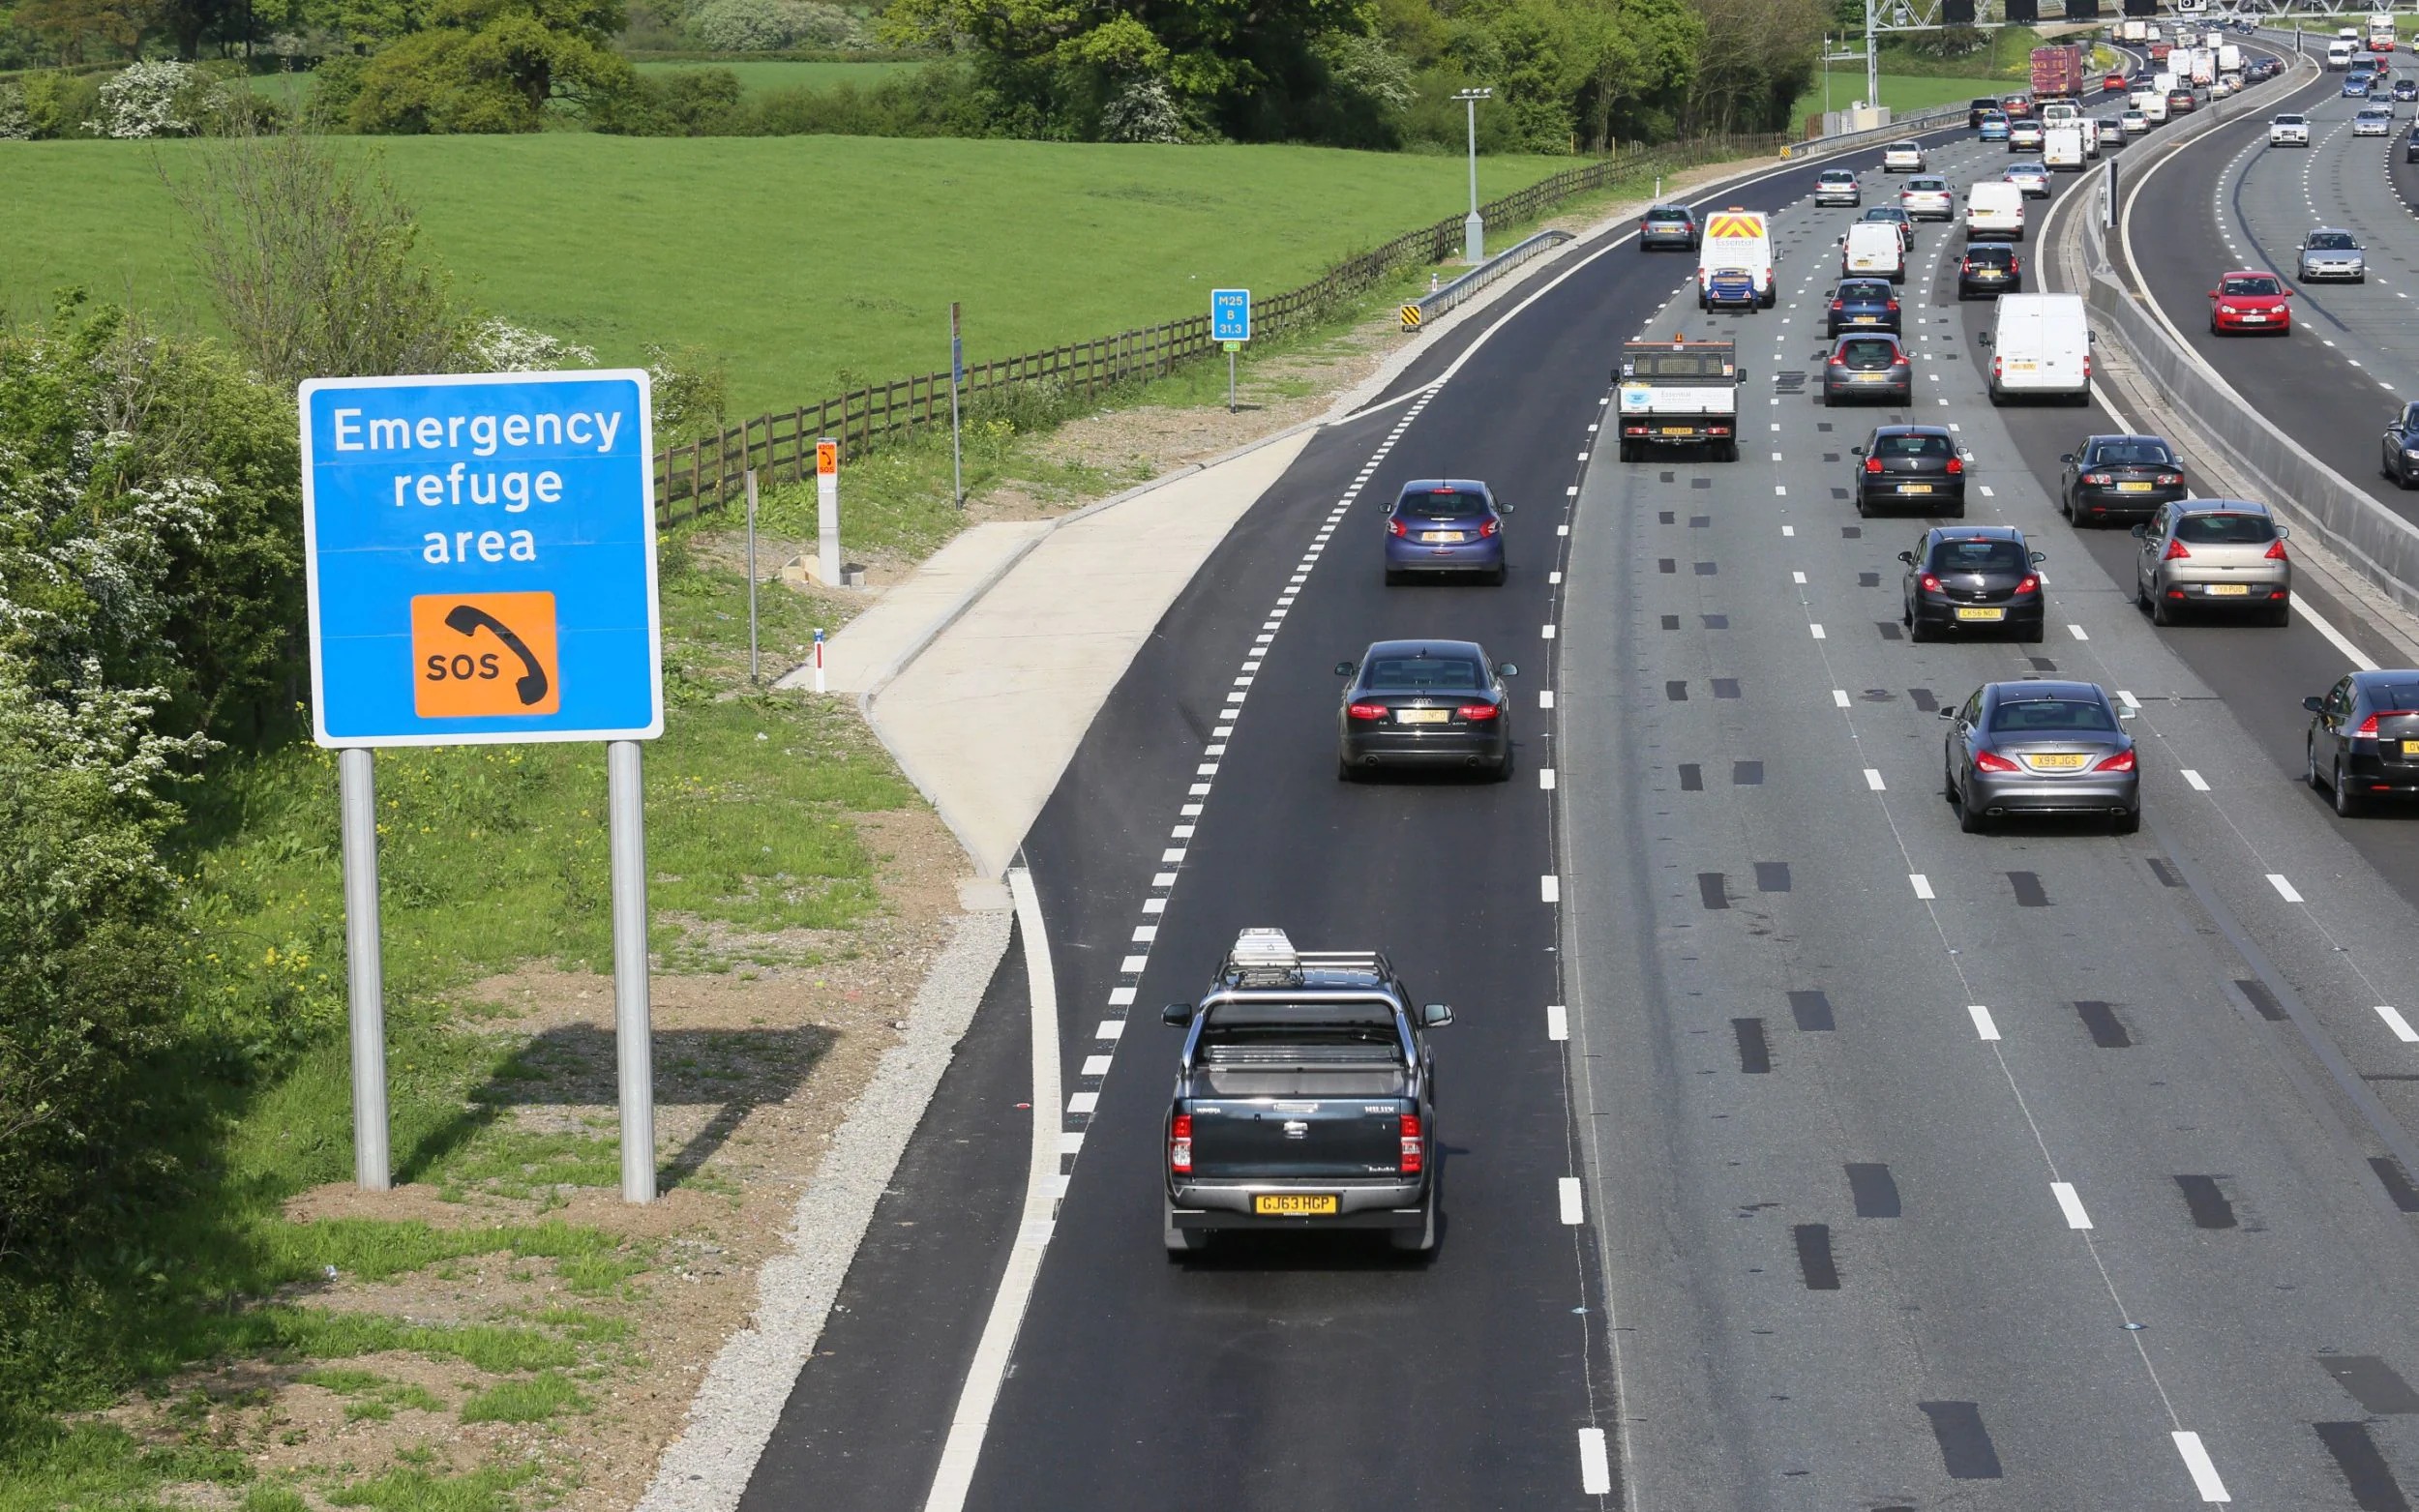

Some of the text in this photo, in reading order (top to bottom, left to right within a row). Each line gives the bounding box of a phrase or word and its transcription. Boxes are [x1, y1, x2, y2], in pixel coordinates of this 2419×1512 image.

[1219, 296, 1243, 306] M25
[1219, 324, 1242, 334] 31.3
[334, 407, 622, 457] Emergency
[394, 461, 563, 513] refuge
[423, 529, 536, 564] area
[426, 653, 499, 681] SOS
[2038, 756, 2077, 765] X99 JGS
[1263, 1197, 1329, 1210] GJ63 HGP
